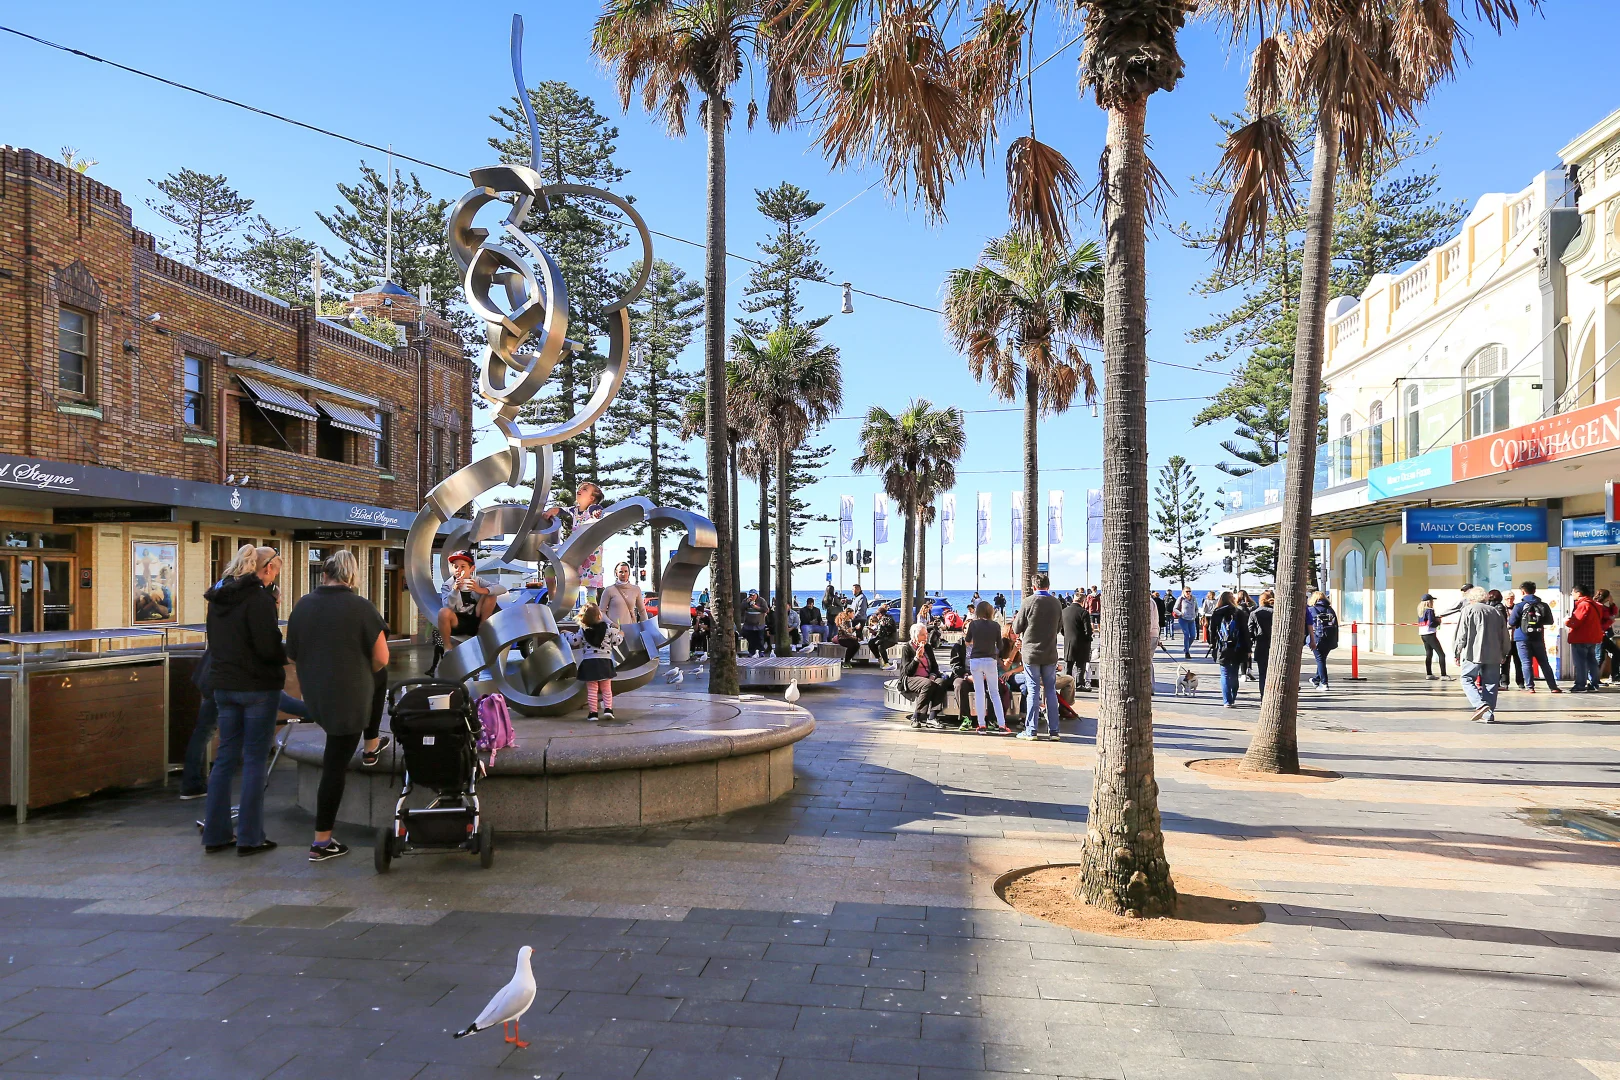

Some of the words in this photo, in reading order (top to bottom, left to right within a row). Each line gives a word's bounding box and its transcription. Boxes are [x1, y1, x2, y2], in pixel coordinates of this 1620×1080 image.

[1531, 418, 1571, 434] ROYAL
[1489, 405, 1620, 468] COPENHAGEN
[13, 463, 74, 489] Steyne
[350, 506, 373, 520] Hotel
[1420, 522, 1454, 532] MANLY
[1458, 521, 1494, 532] OCEAN
[1497, 522, 1532, 532] FOODS
[1573, 530, 1590, 539] MANLY
[1591, 528, 1610, 537] OCEAN
